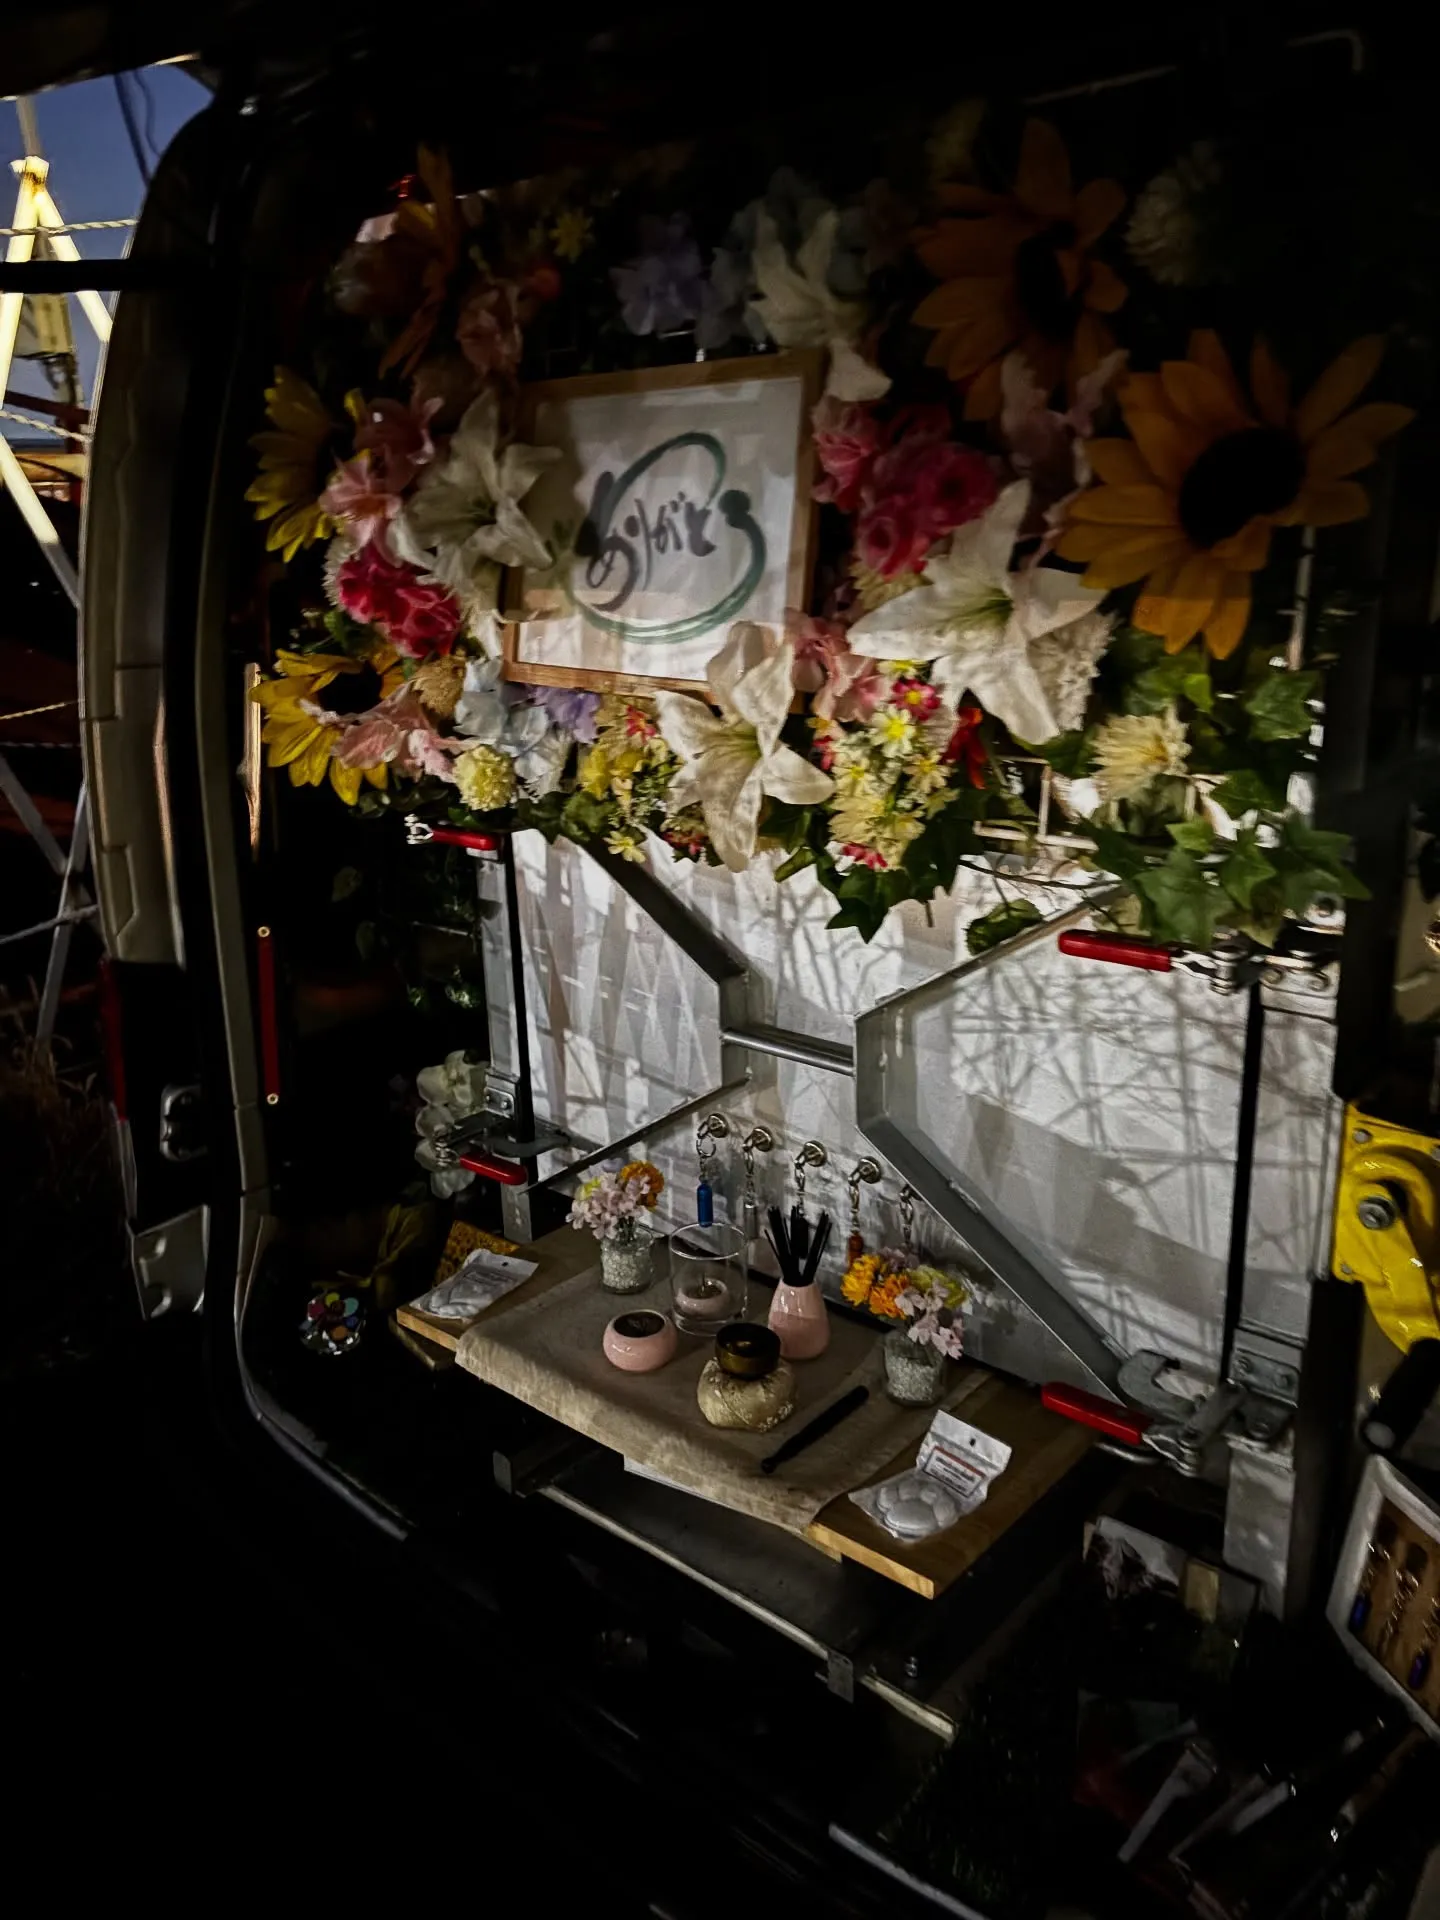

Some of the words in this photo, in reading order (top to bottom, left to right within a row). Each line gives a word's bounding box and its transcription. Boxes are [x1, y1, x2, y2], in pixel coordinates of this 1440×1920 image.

[566, 432, 767, 645] ありがとう
